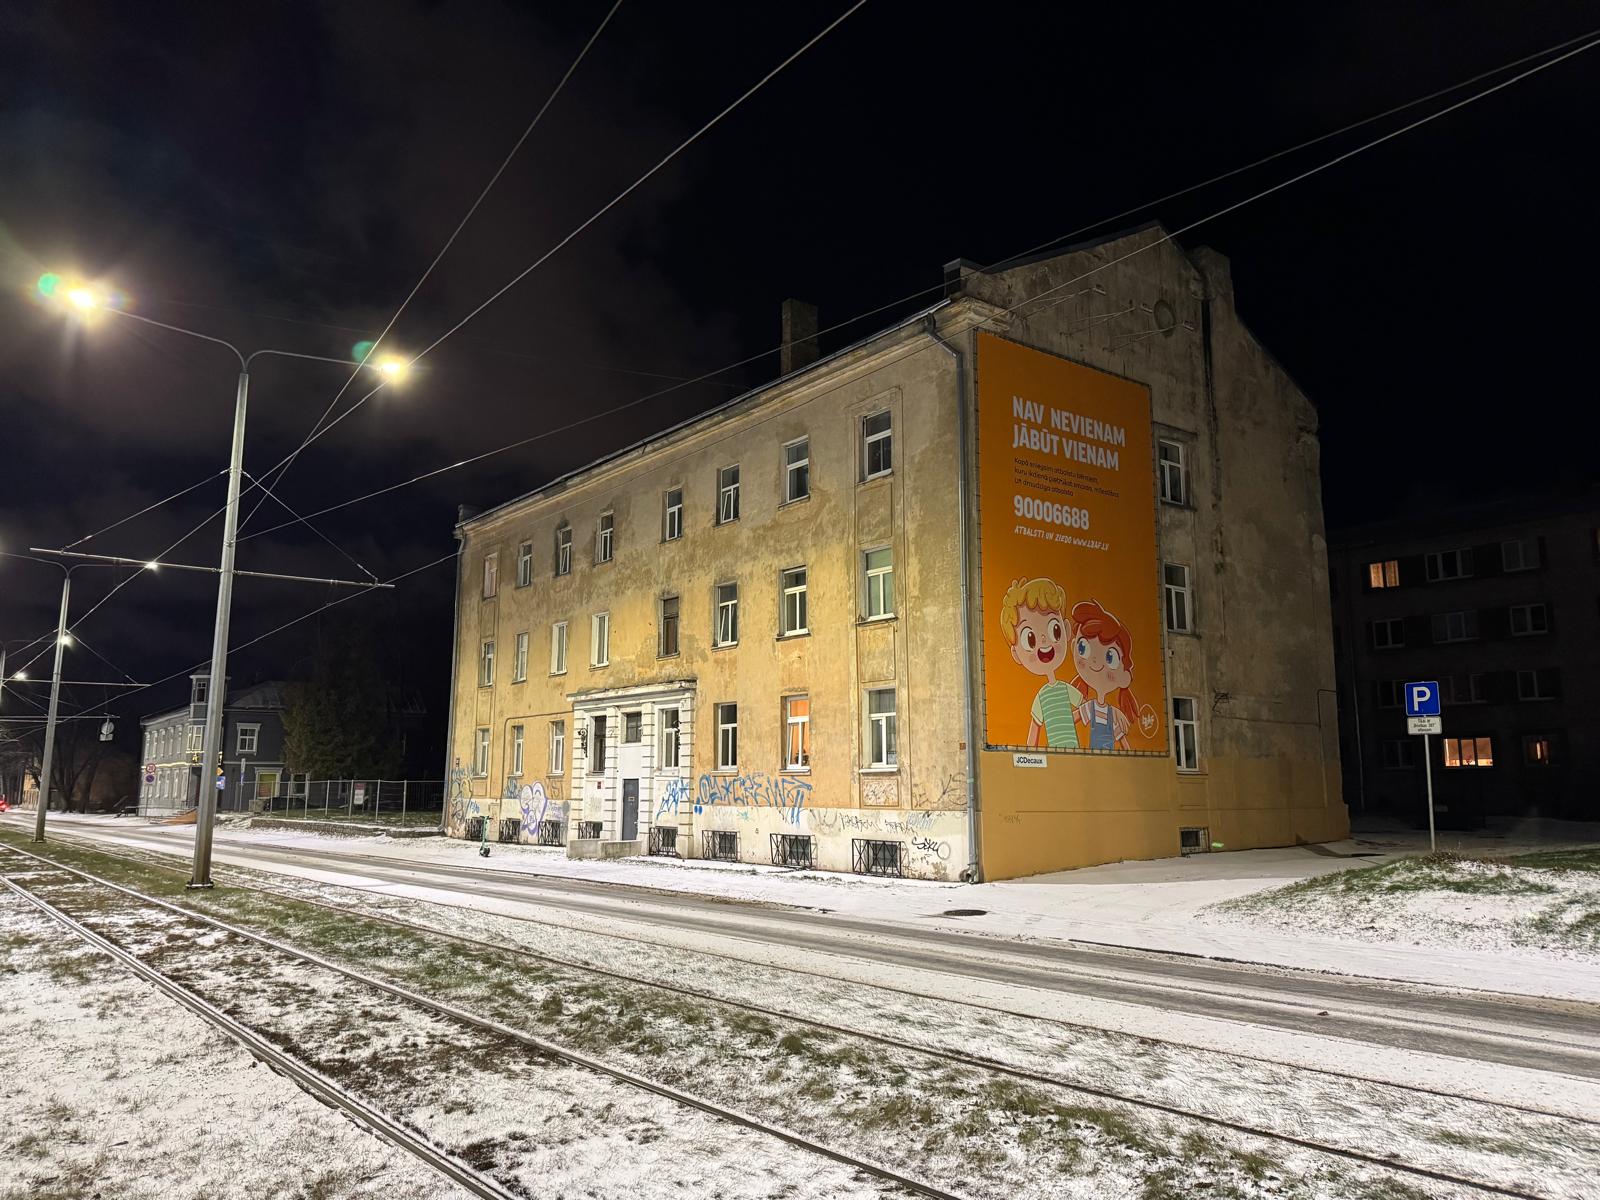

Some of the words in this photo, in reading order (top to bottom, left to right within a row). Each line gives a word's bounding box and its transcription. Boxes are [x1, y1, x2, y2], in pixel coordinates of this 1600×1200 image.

[1012, 395, 1044, 425] NAV
[1050, 407, 1126, 448] NEVIENAM
[1012, 422, 1059, 456] JĀBŪT
[1062, 437, 1119, 471] VIENAM
[1013, 494, 1089, 530] 90006688
[1014, 525, 1045, 539] ATBALSTI
[1045, 531, 1054, 541] UN
[1054, 533, 1072, 544] ZIEDO
[1412, 686, 1431, 712] P
[1016, 756, 1043, 764] JCDecaux
